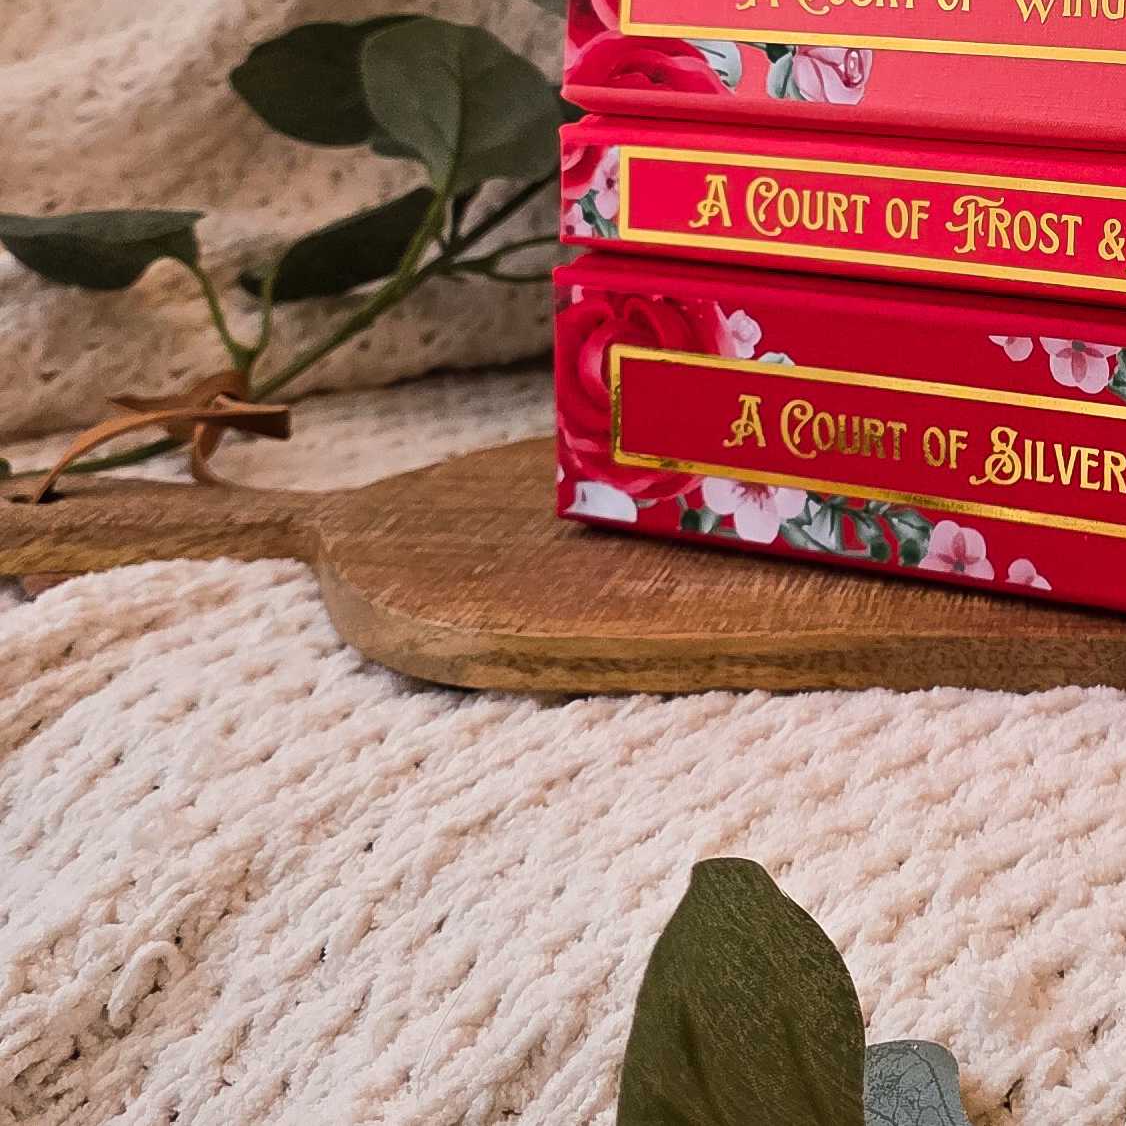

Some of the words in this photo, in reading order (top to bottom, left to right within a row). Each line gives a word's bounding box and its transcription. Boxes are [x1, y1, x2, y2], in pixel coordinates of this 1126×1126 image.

[689, 174, 732, 228] A
[746, 177, 872, 236] COURT
[885, 199, 932, 240] OF
[947, 195, 1083, 256] FROST
[1098, 219, 1126, 262] &
[724, 394, 766, 448] A
[780, 399, 907, 460] COURT
[923, 427, 969, 469] OF
